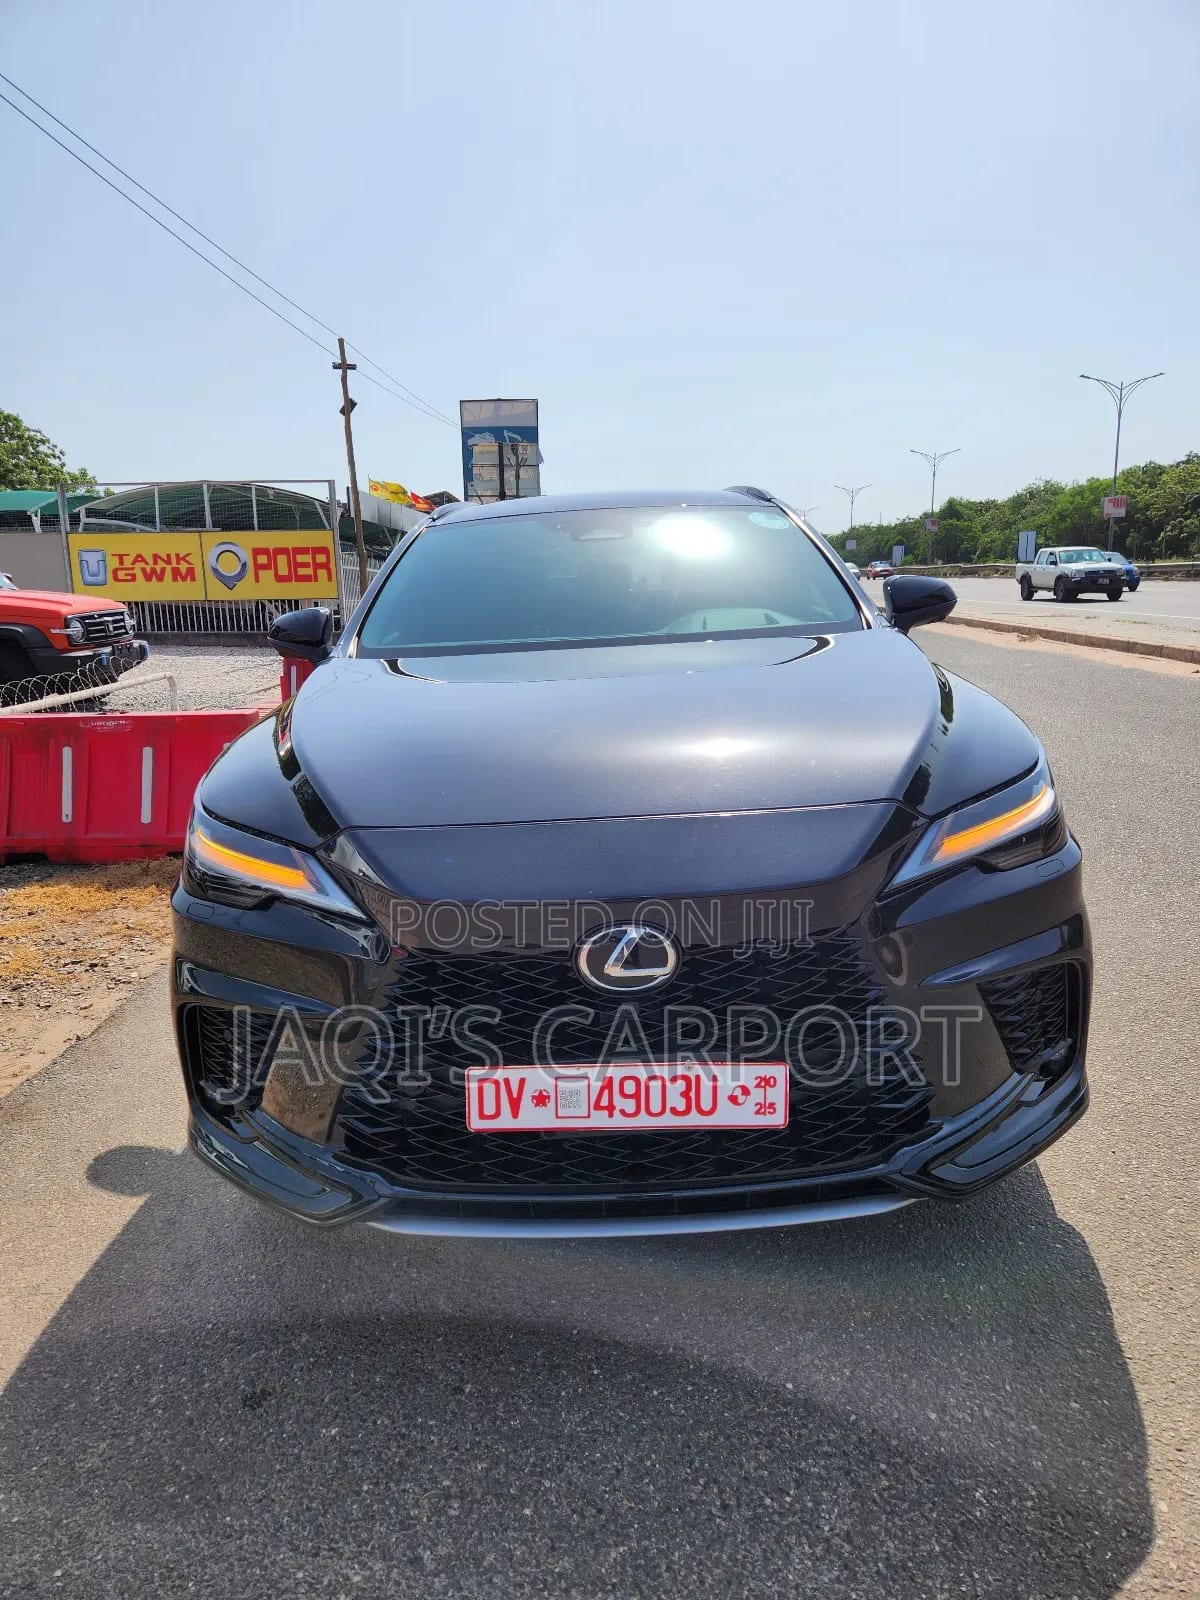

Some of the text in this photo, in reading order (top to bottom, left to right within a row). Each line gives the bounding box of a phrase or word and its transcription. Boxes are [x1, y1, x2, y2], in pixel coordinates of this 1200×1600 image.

[111, 553, 195, 566] TANK
[252, 546, 333, 584] POER
[112, 566, 197, 583] GWM
[754, 1075, 777, 1089] 20
[477, 1076, 527, 1121] DV
